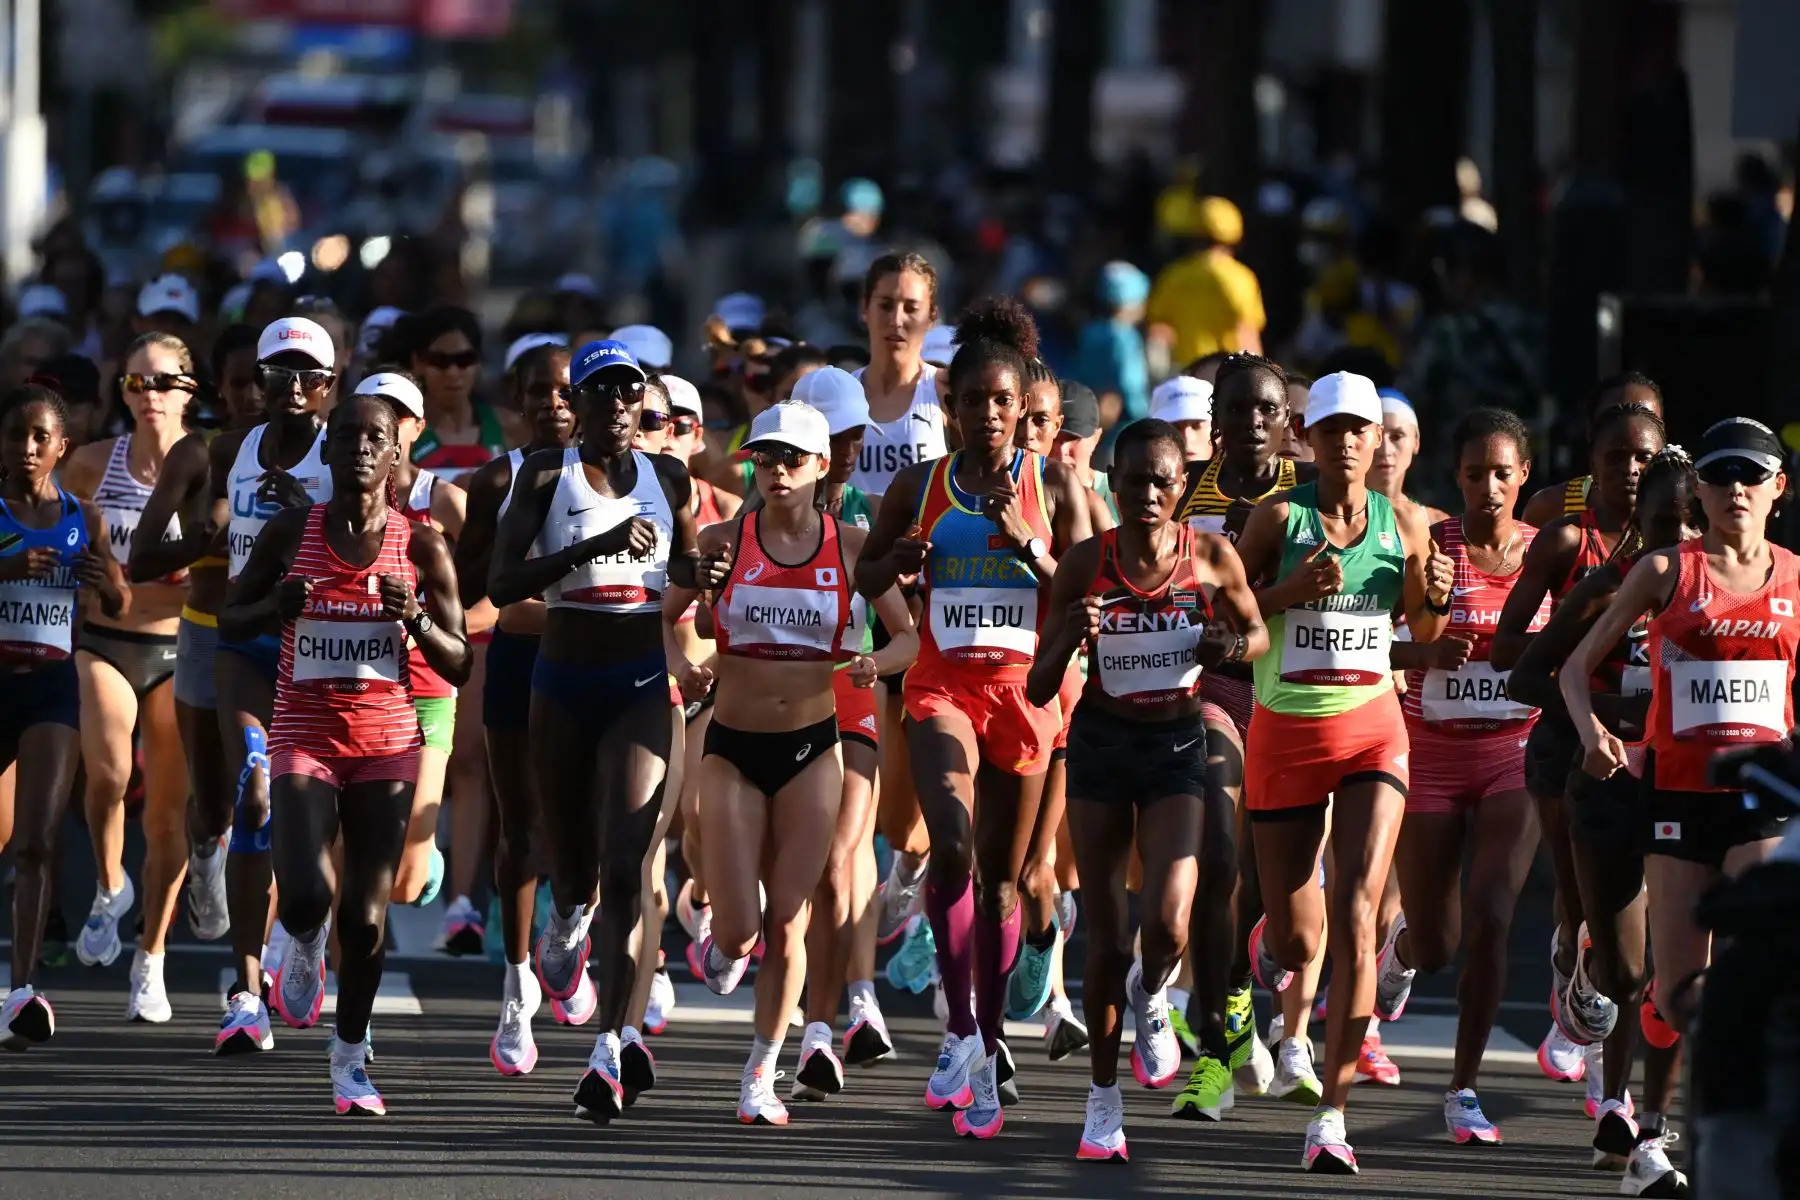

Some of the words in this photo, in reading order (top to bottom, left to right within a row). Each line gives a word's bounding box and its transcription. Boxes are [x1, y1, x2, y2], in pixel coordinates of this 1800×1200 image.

[278, 328, 313, 341] USA
[584, 348, 634, 365] ISRAEL
[860, 443, 927, 473] UISSE
[230, 532, 253, 556] KIP
[745, 604, 822, 627] ICHIYAMA
[943, 604, 1024, 628] WELDU
[1099, 610, 1191, 632] KENYA
[1296, 625, 1379, 652] DEREJE
[1700, 618, 1782, 639] JAPAN
[298, 635, 395, 661] CHUMBA
[1446, 678, 1509, 701] DABA
[1691, 679, 1771, 704] MAEDA
